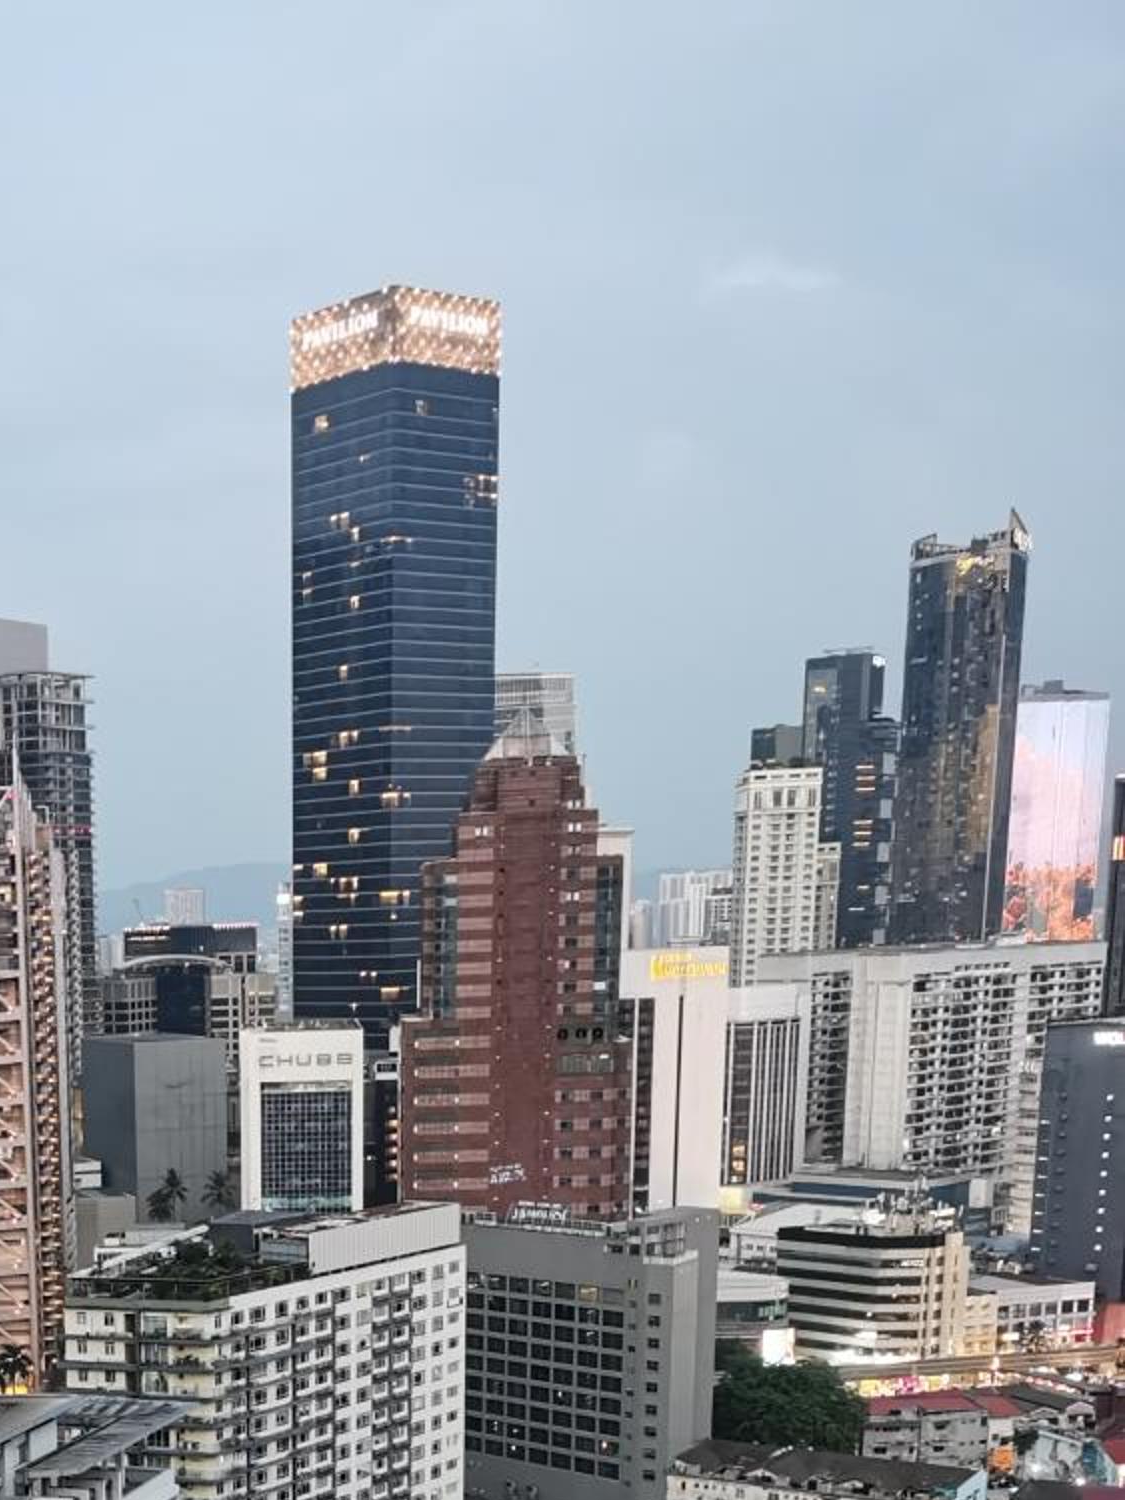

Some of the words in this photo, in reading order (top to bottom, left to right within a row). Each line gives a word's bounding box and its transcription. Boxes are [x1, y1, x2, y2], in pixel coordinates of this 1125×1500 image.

[301, 309, 379, 351] PAVILION
[410, 305, 489, 335] PAVILION
[258, 1053, 353, 1067] CHUBB
